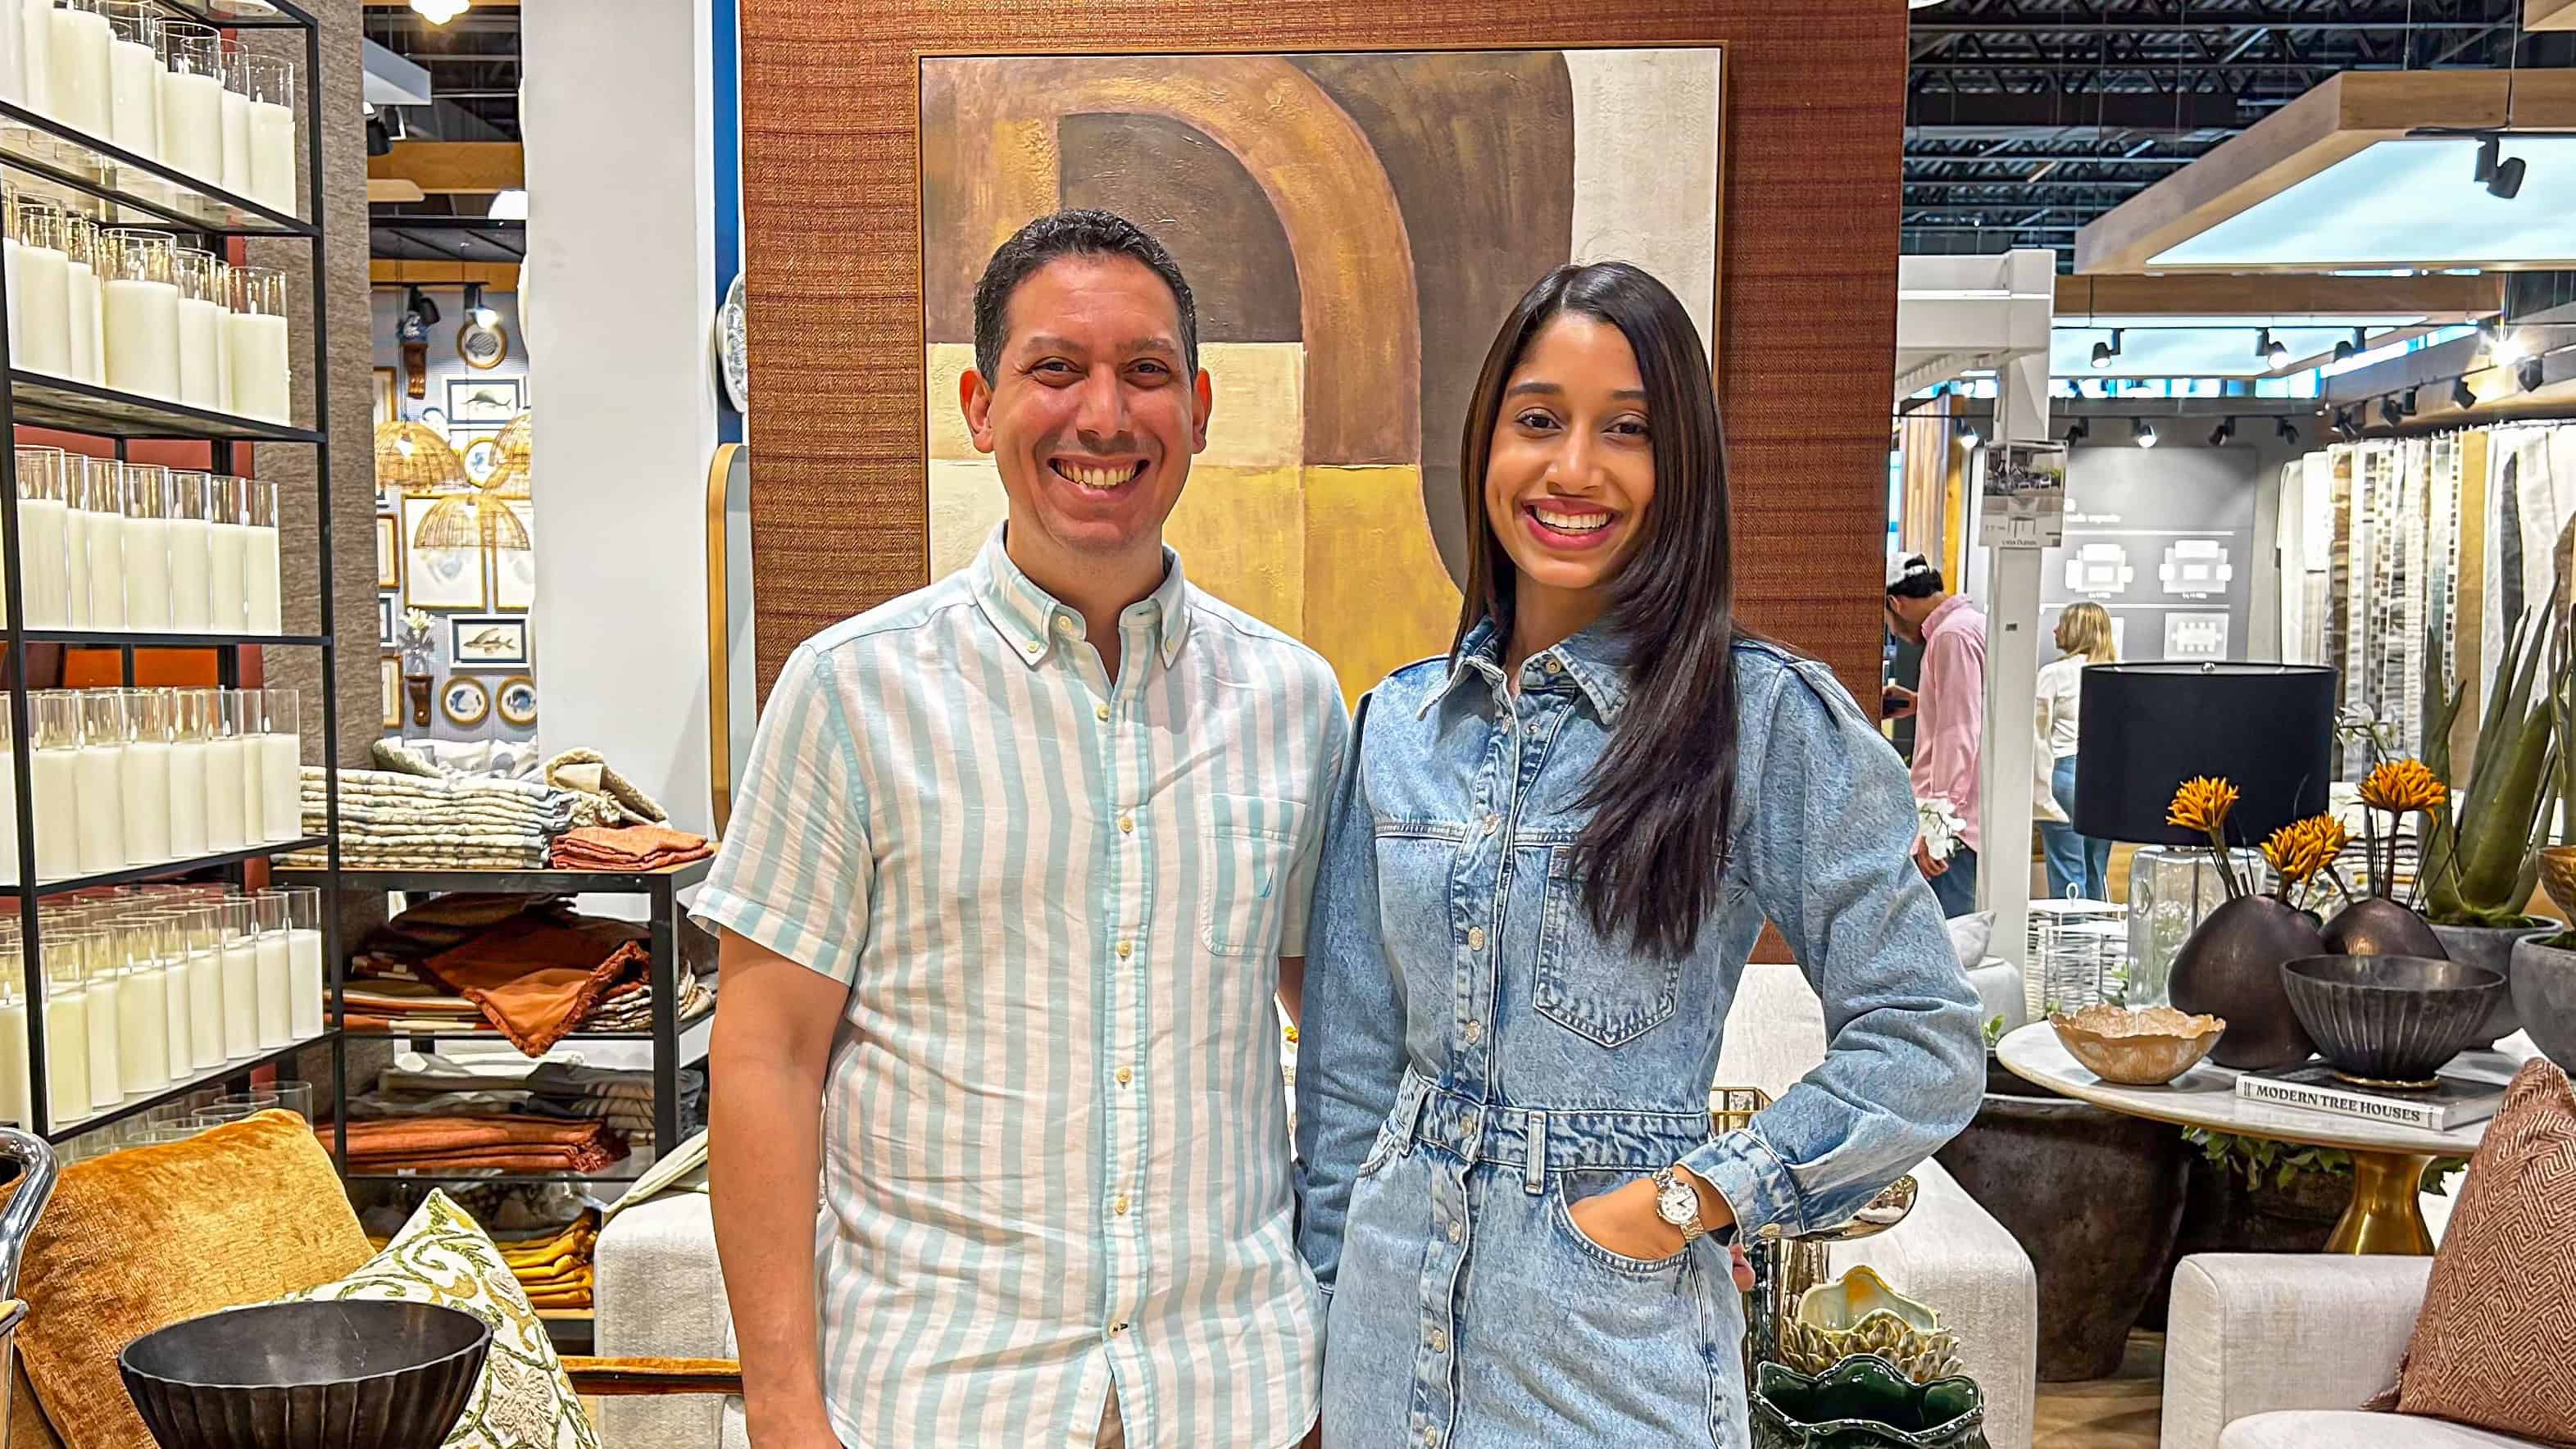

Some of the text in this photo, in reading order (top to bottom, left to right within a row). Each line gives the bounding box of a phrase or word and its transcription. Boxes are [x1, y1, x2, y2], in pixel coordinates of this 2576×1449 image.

[2256, 1085, 2420, 1122] MODERN TREE HOUSES
